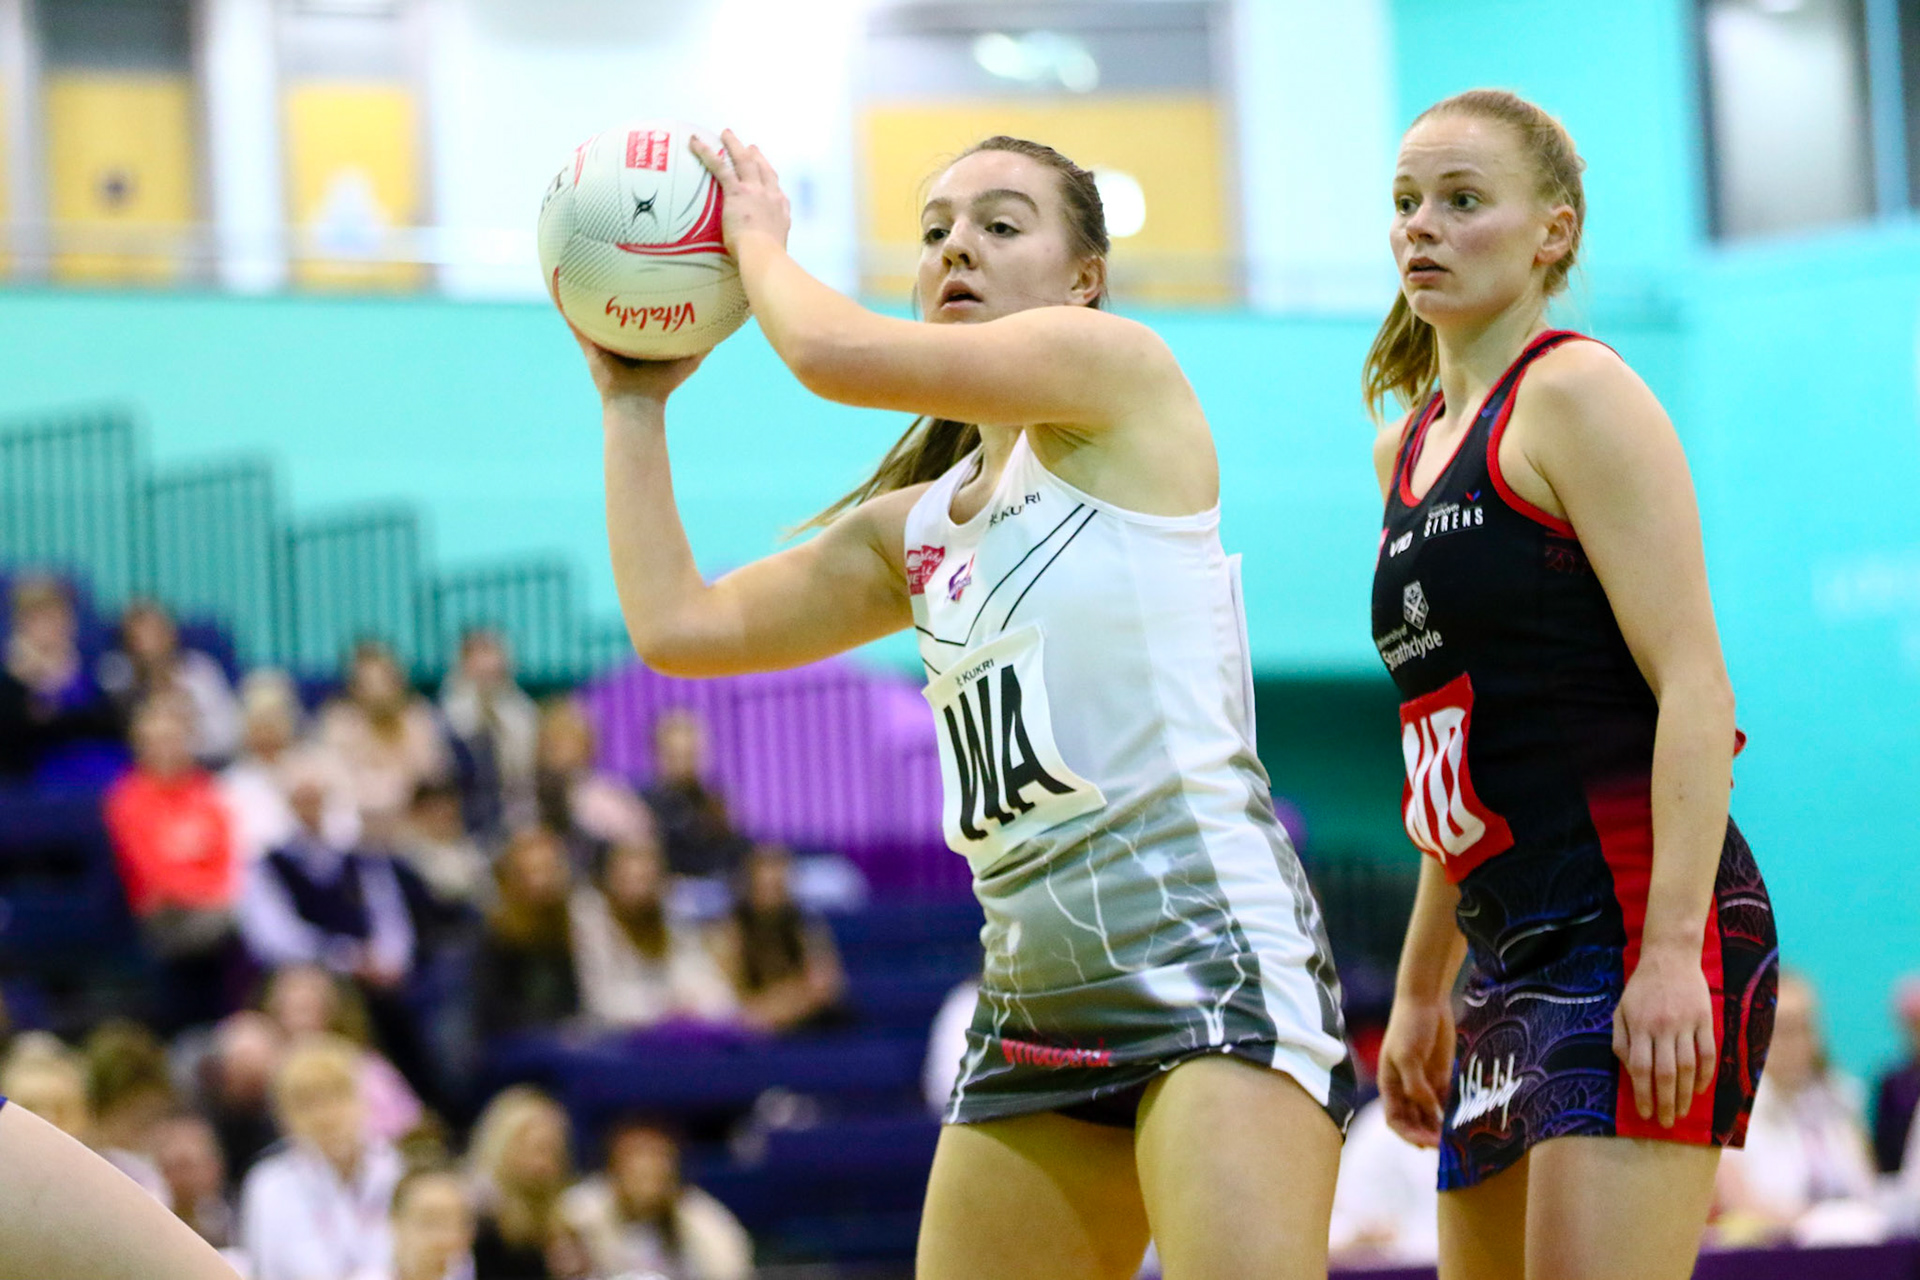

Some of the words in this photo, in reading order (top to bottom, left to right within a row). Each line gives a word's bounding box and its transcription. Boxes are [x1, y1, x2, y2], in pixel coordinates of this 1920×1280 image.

[605, 295, 696, 333] Vitality
[1423, 507, 1484, 538] SIRENS
[1381, 629, 1443, 671] Strathclyde
[962, 658, 995, 683] KUKRI
[943, 664, 1077, 841] WA
[1402, 706, 1486, 865] WD
